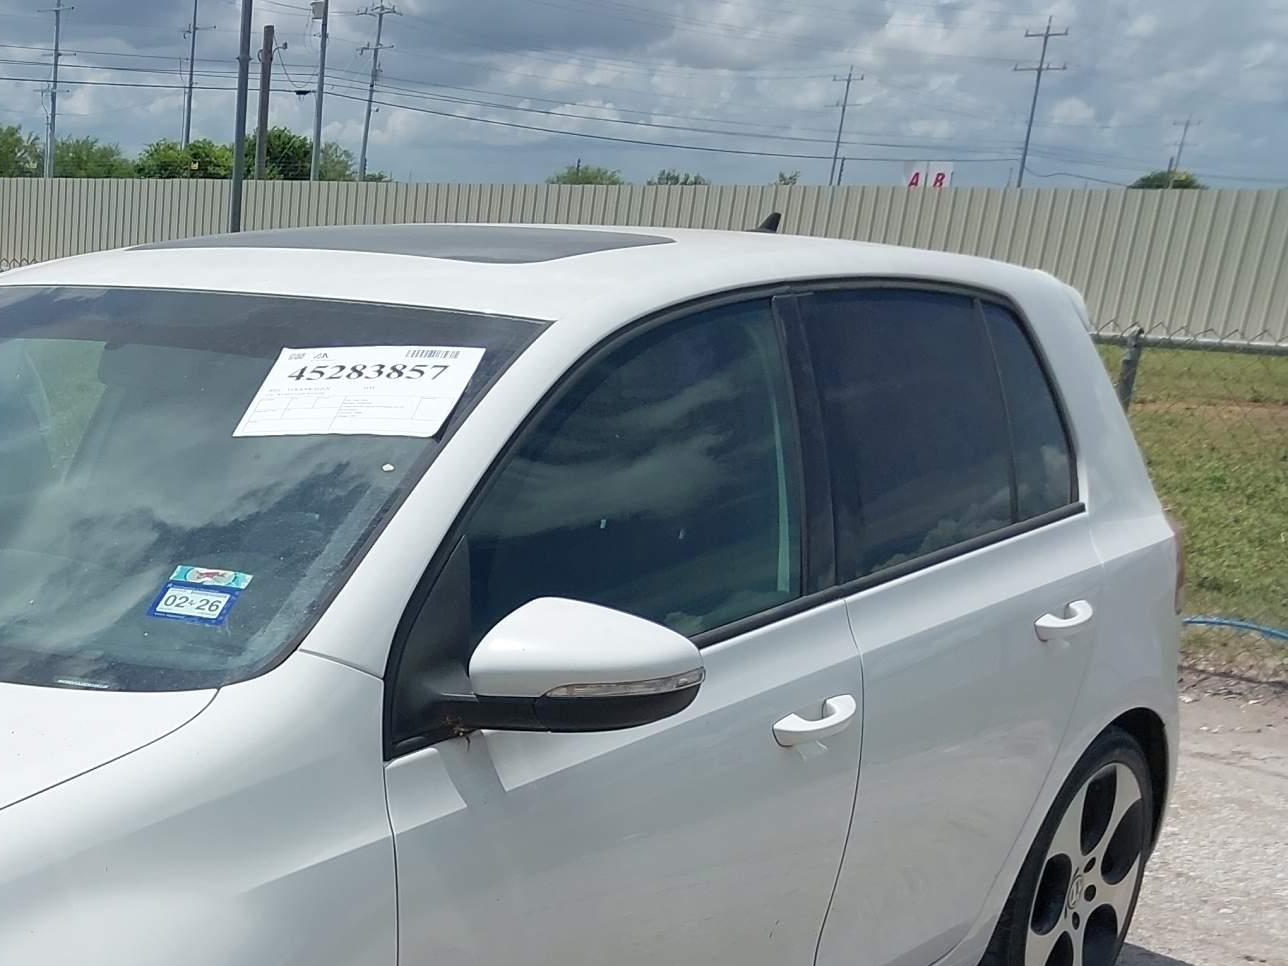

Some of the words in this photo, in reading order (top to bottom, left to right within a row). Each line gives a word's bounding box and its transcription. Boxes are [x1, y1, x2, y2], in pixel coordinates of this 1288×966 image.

[908, 172, 919, 187] A
[287, 364, 451, 381] 45283857
[163, 594, 189, 608] 02
[196, 598, 222, 612] 26
